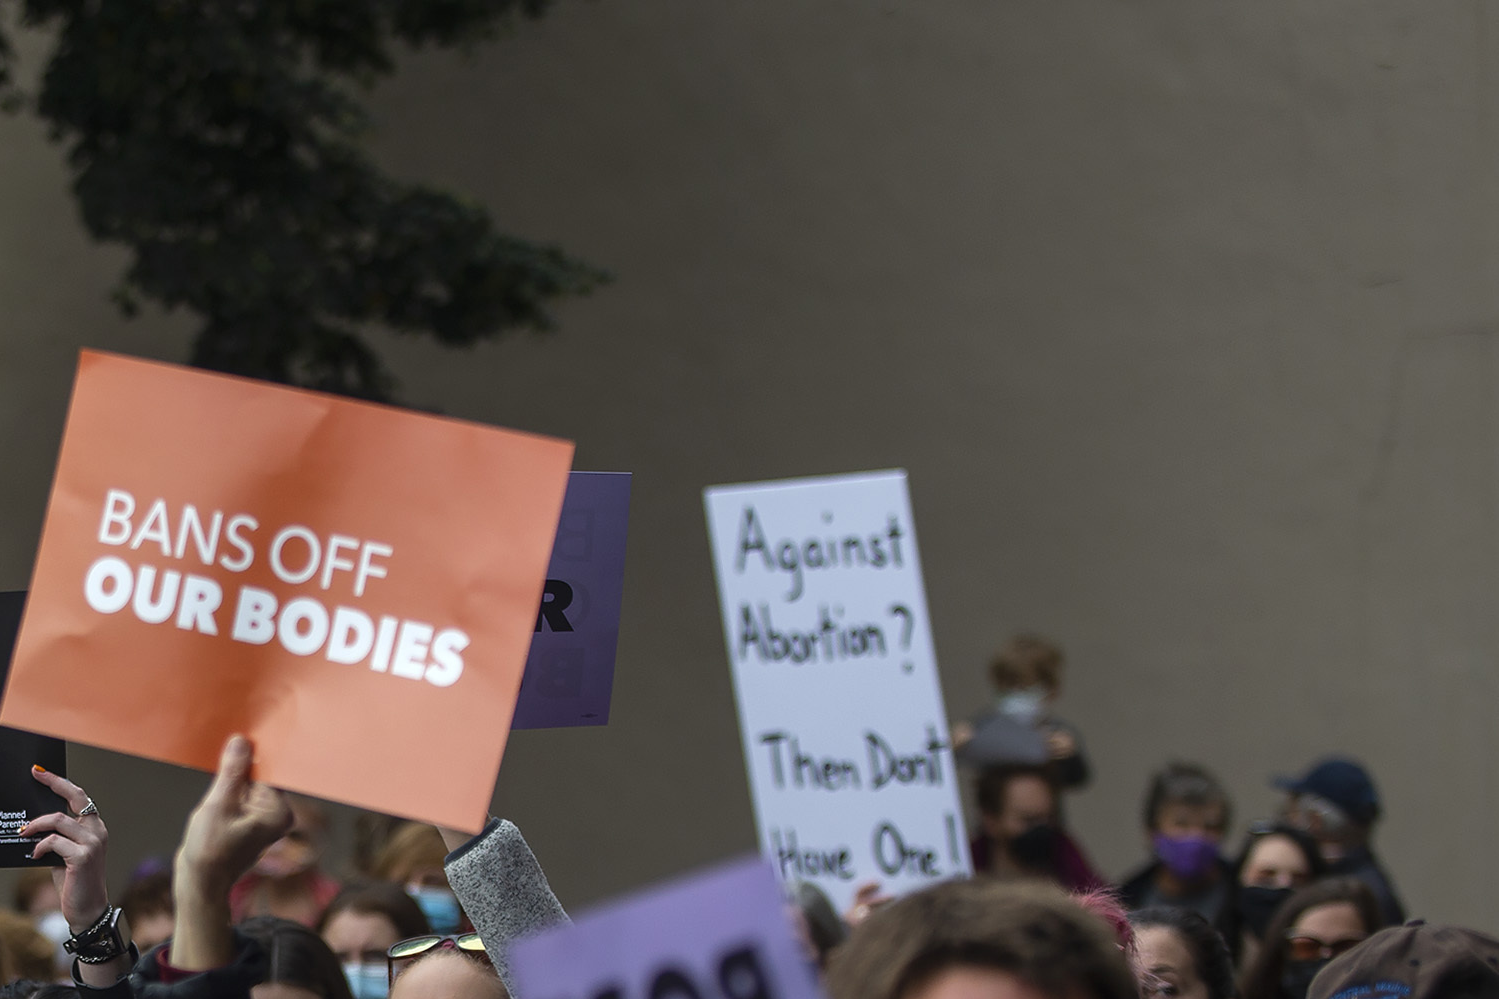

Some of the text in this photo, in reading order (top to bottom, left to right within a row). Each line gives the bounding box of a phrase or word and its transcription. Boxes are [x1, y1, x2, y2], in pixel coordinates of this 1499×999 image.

[98, 488, 394, 597] BANS OFF
[734, 505, 905, 601] Against
[84, 556, 470, 687] OUR BODIES
[739, 603, 915, 675] Abortion?
[760, 731, 862, 790] Then
[769, 828, 855, 880] Have
